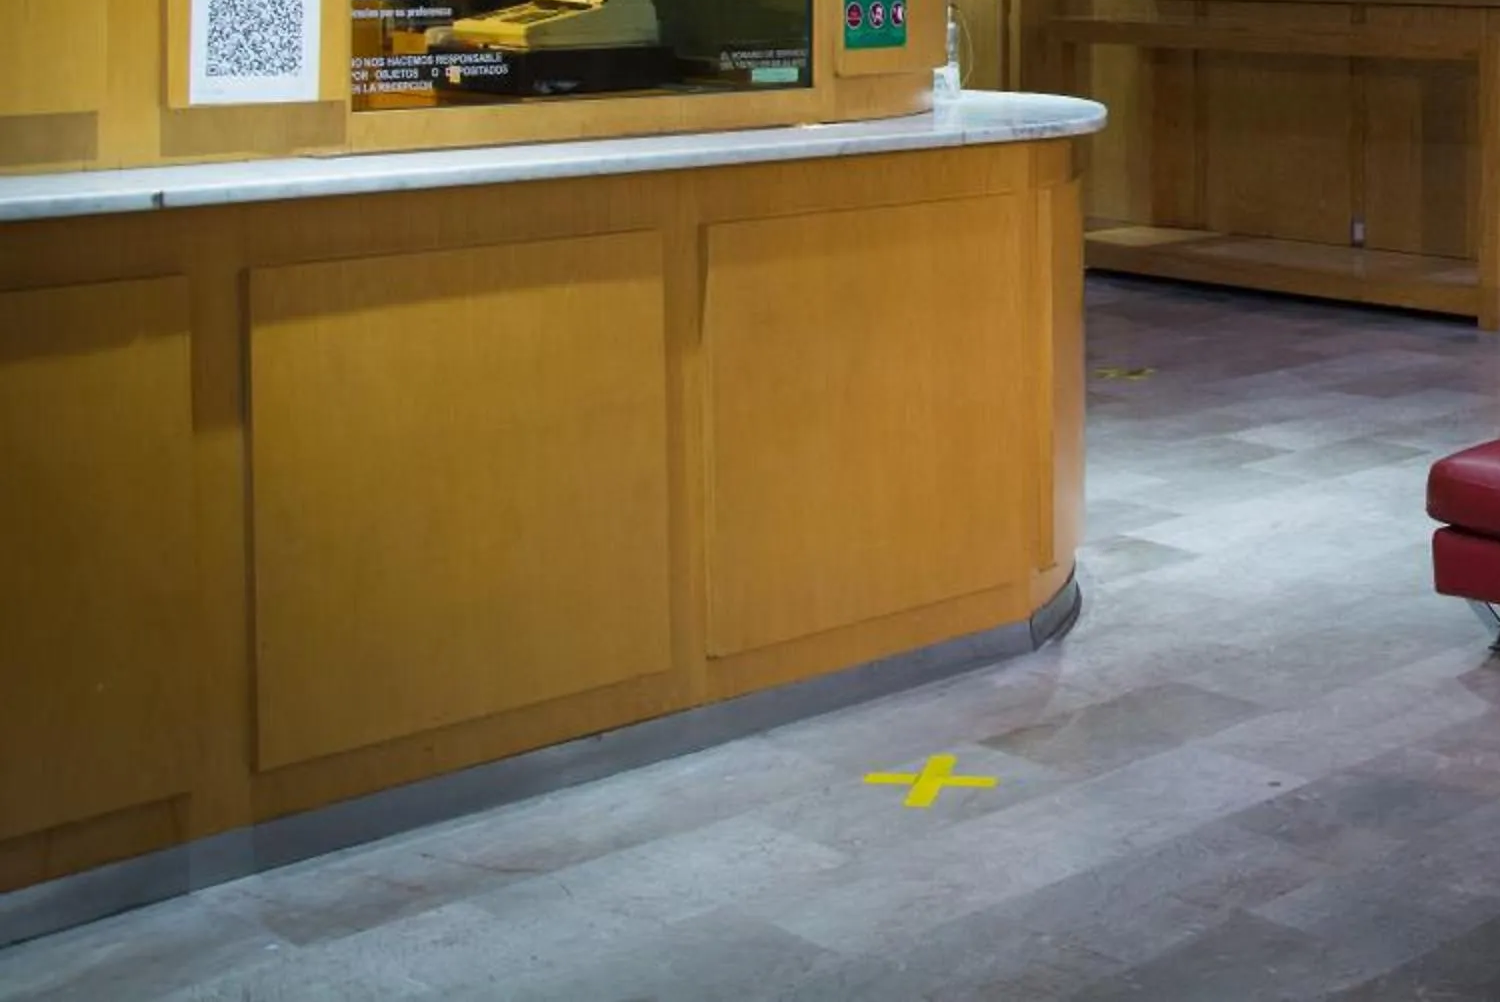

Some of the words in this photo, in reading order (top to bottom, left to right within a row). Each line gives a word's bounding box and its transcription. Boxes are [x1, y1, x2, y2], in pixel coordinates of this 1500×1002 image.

[386, 55, 433, 67] HACEMOS
[435, 52, 503, 65] RESPONSABLE
[375, 68, 419, 80] OBJETOS
